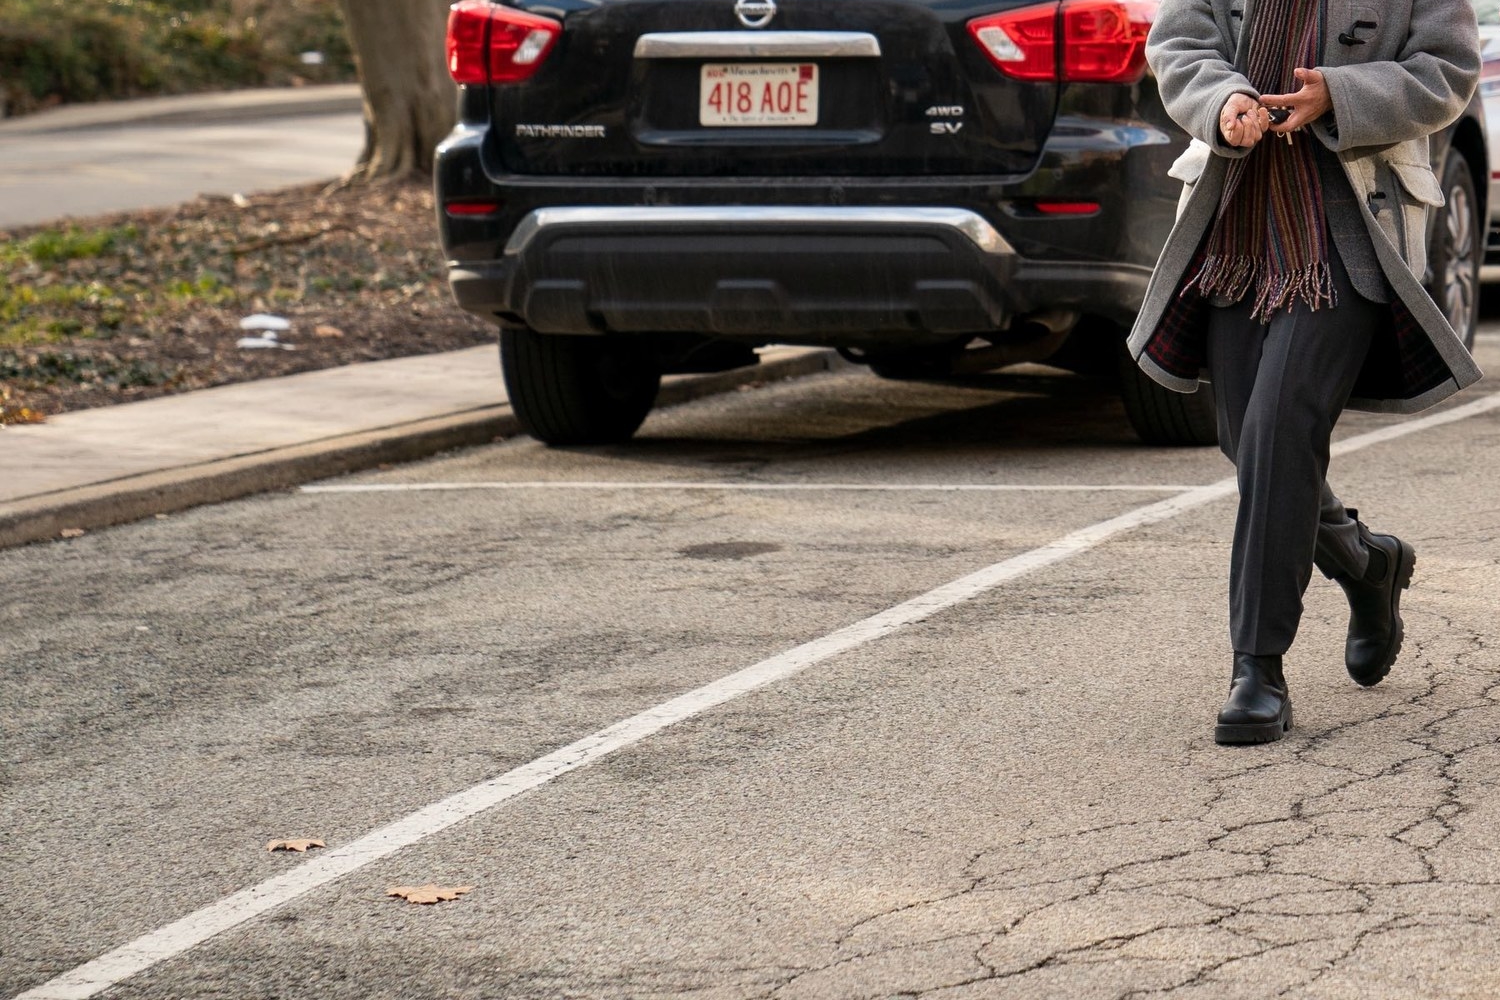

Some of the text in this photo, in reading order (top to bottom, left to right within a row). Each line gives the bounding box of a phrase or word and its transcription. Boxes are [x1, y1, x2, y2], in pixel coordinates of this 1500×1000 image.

[707, 81, 808, 114] 418 AQE
[925, 105, 964, 116] 4WD
[515, 123, 606, 138] PATHFINDER
[930, 122, 962, 134] SV
